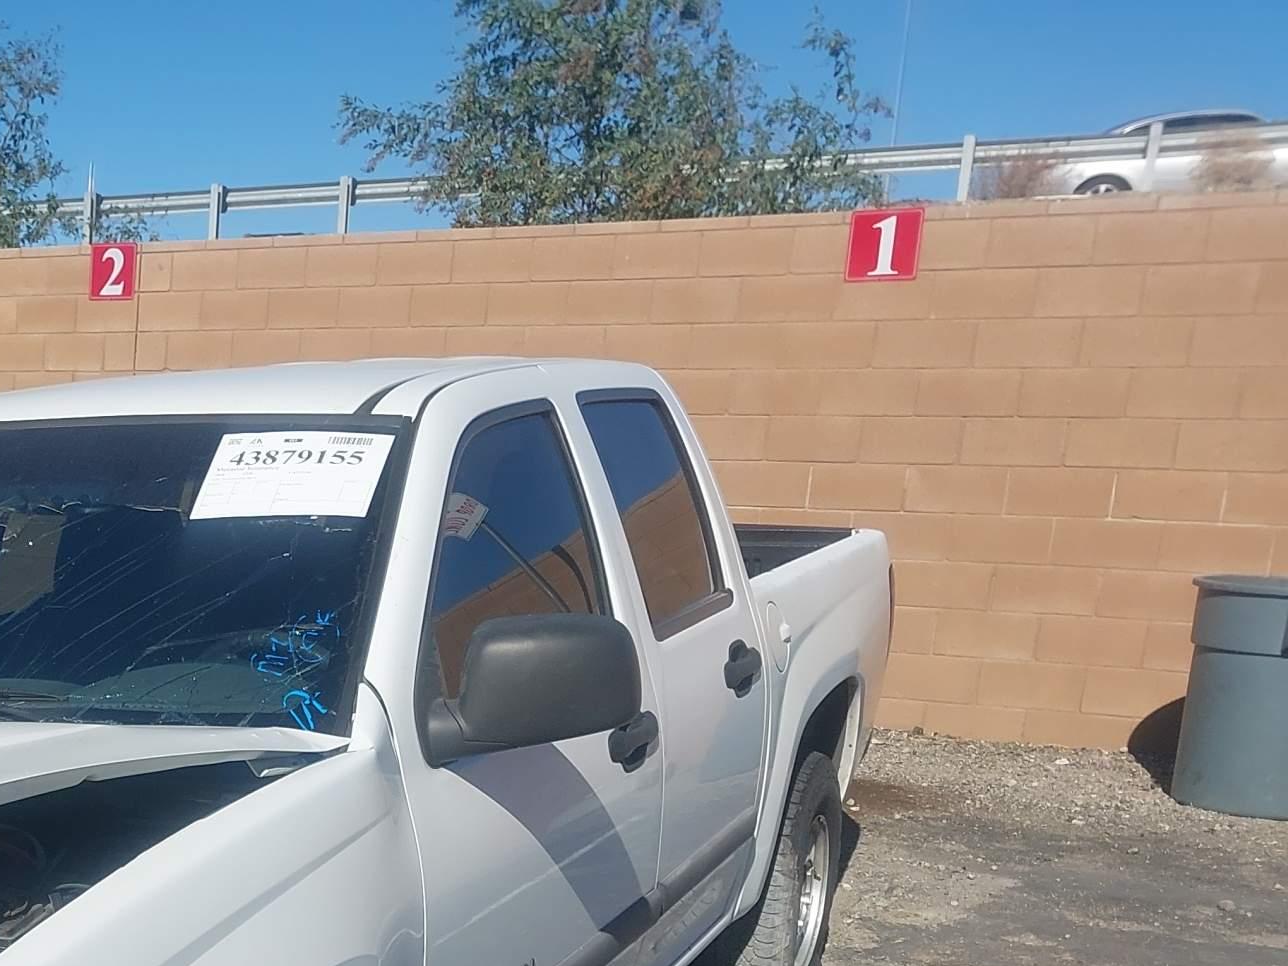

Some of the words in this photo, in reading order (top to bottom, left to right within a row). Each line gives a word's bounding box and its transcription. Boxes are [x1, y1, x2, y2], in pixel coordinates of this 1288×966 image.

[866, 215, 899, 276] 1
[98, 247, 125, 296] 2
[229, 449, 365, 466] 43879155
